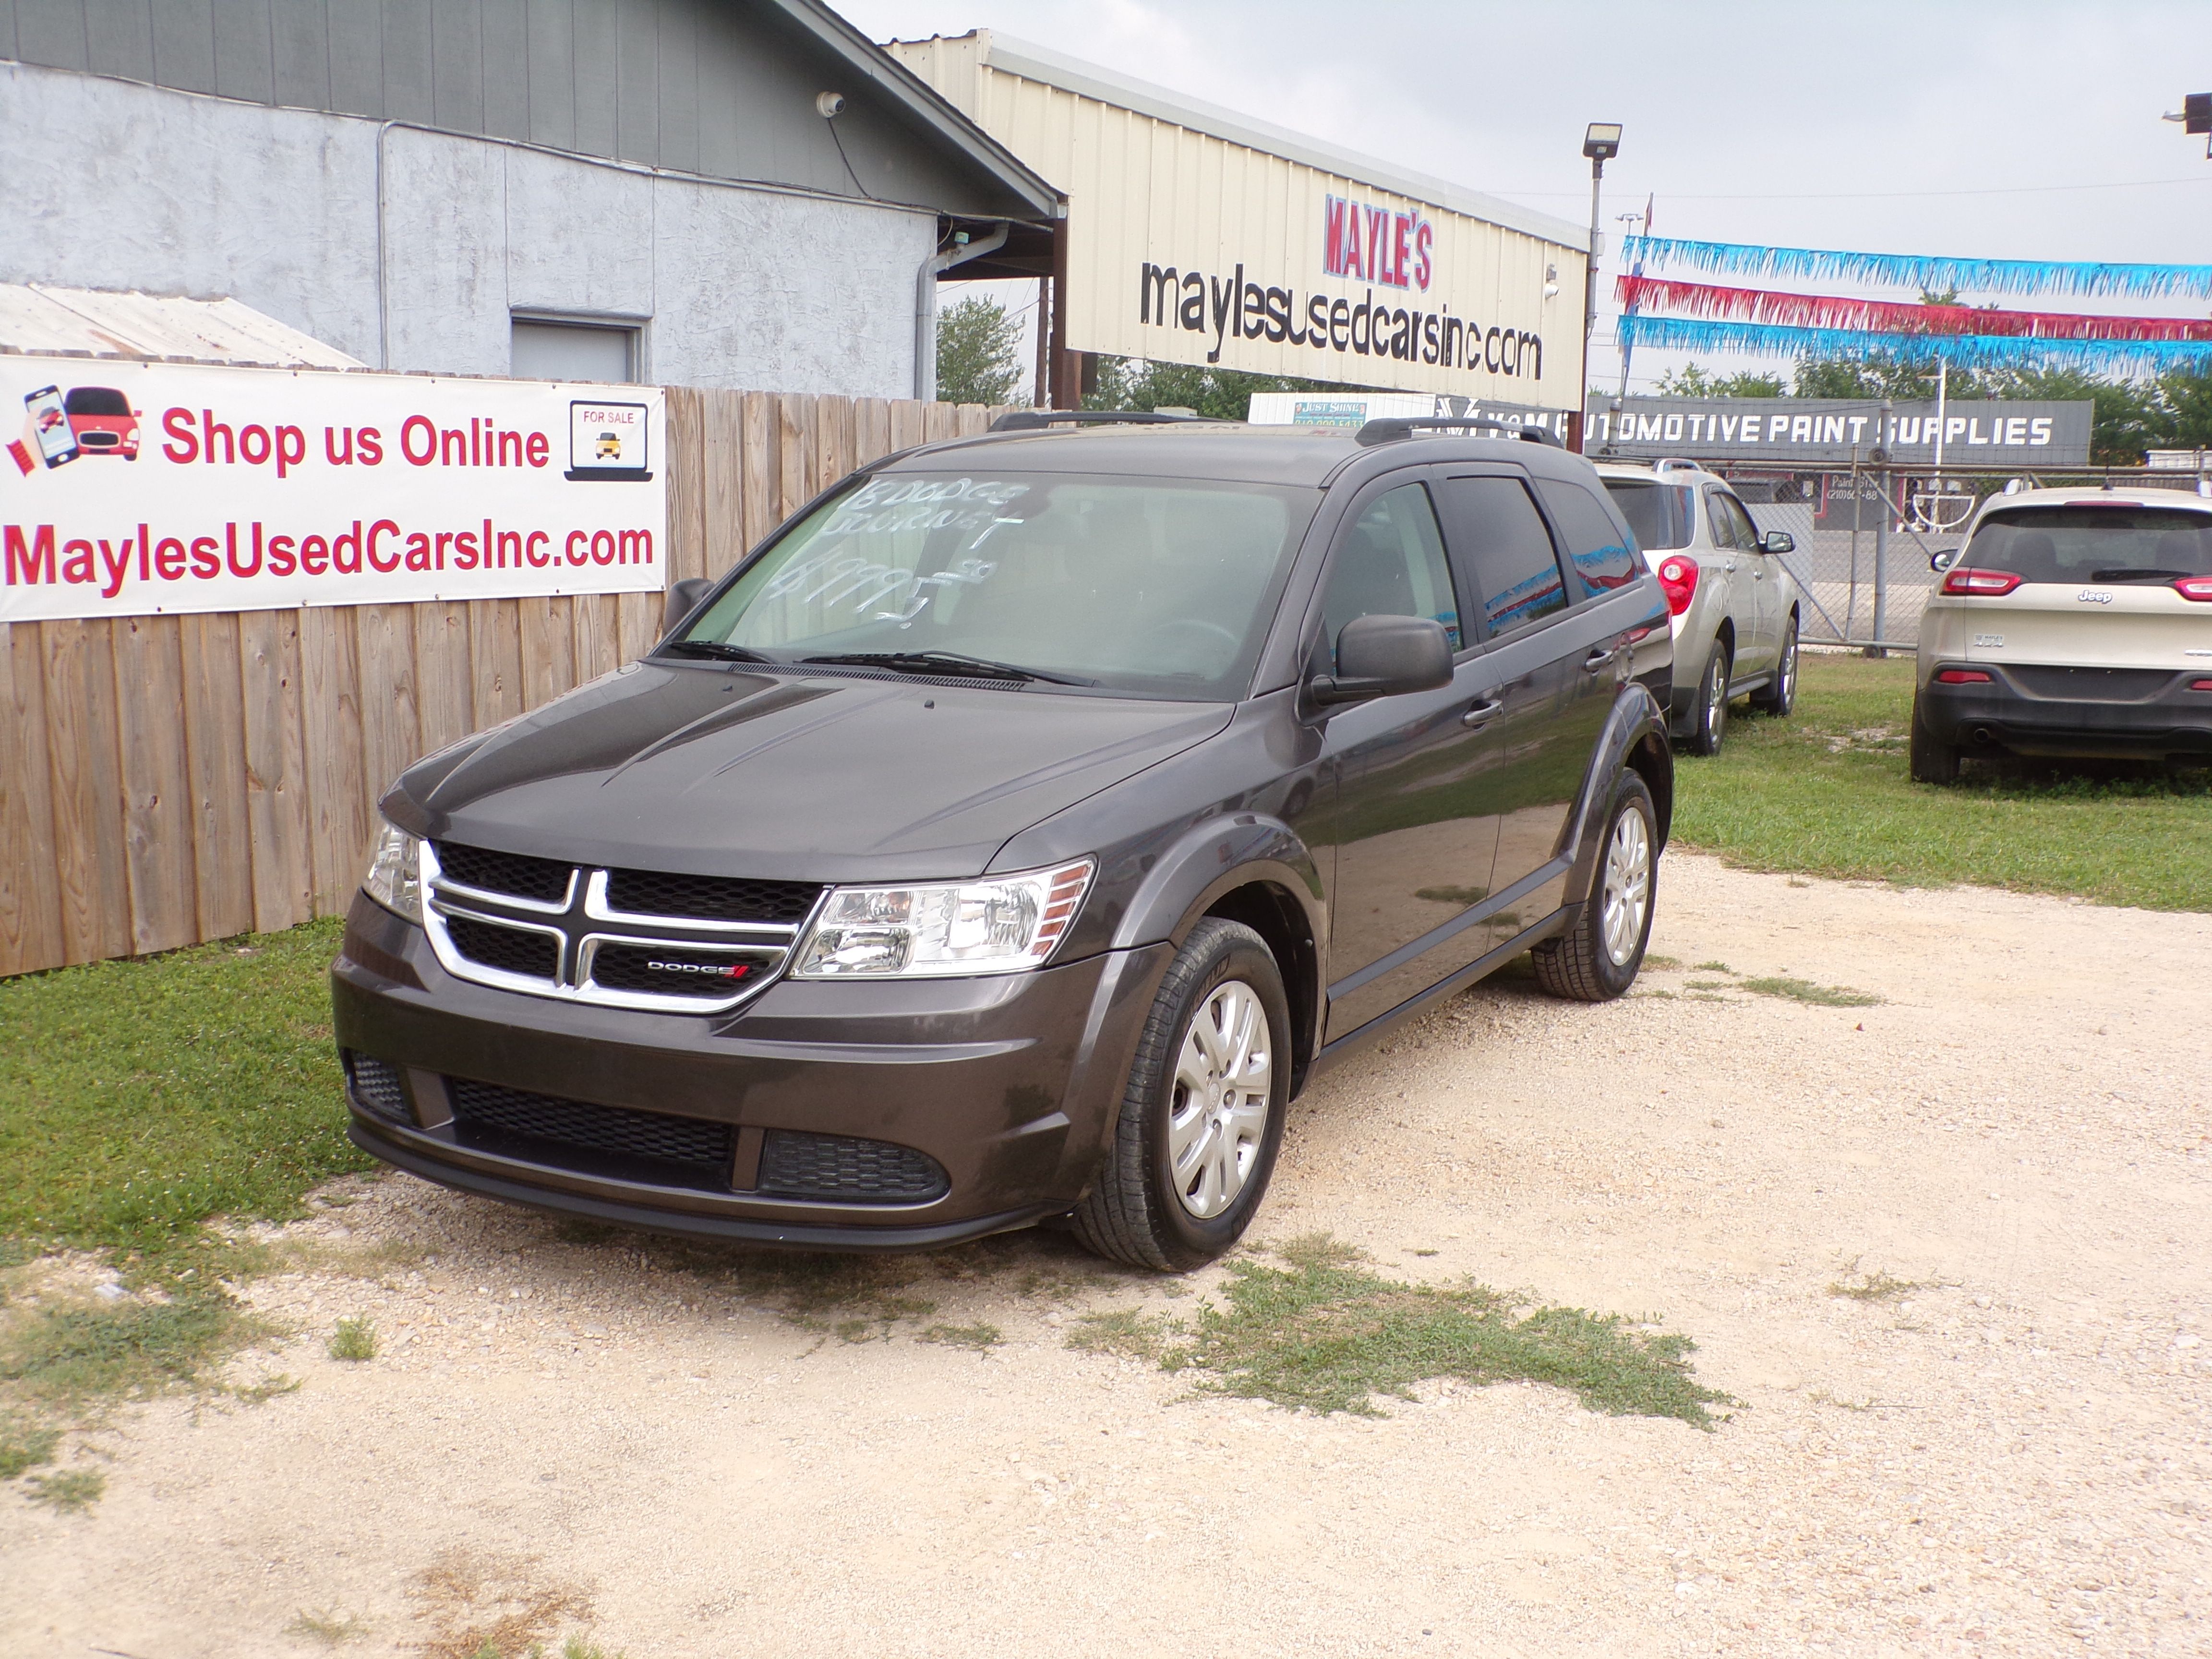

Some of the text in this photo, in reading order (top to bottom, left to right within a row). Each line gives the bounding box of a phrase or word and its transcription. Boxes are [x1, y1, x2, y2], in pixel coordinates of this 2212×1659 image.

[1323, 193, 1434, 293] MAYLE'S
[1140, 262, 1542, 381] maylesusedcarsinc.com
[583, 411, 634, 424] FOR SALE
[1303, 402, 1328, 412] JUST
[162, 407, 550, 478] Shop us Online
[1768, 415, 1868, 444] PAINT
[4, 519, 653, 599] MaylesUsedCarsInc.com
[2078, 589, 2112, 604] Jeep
[648, 962, 736, 975] DODGE
